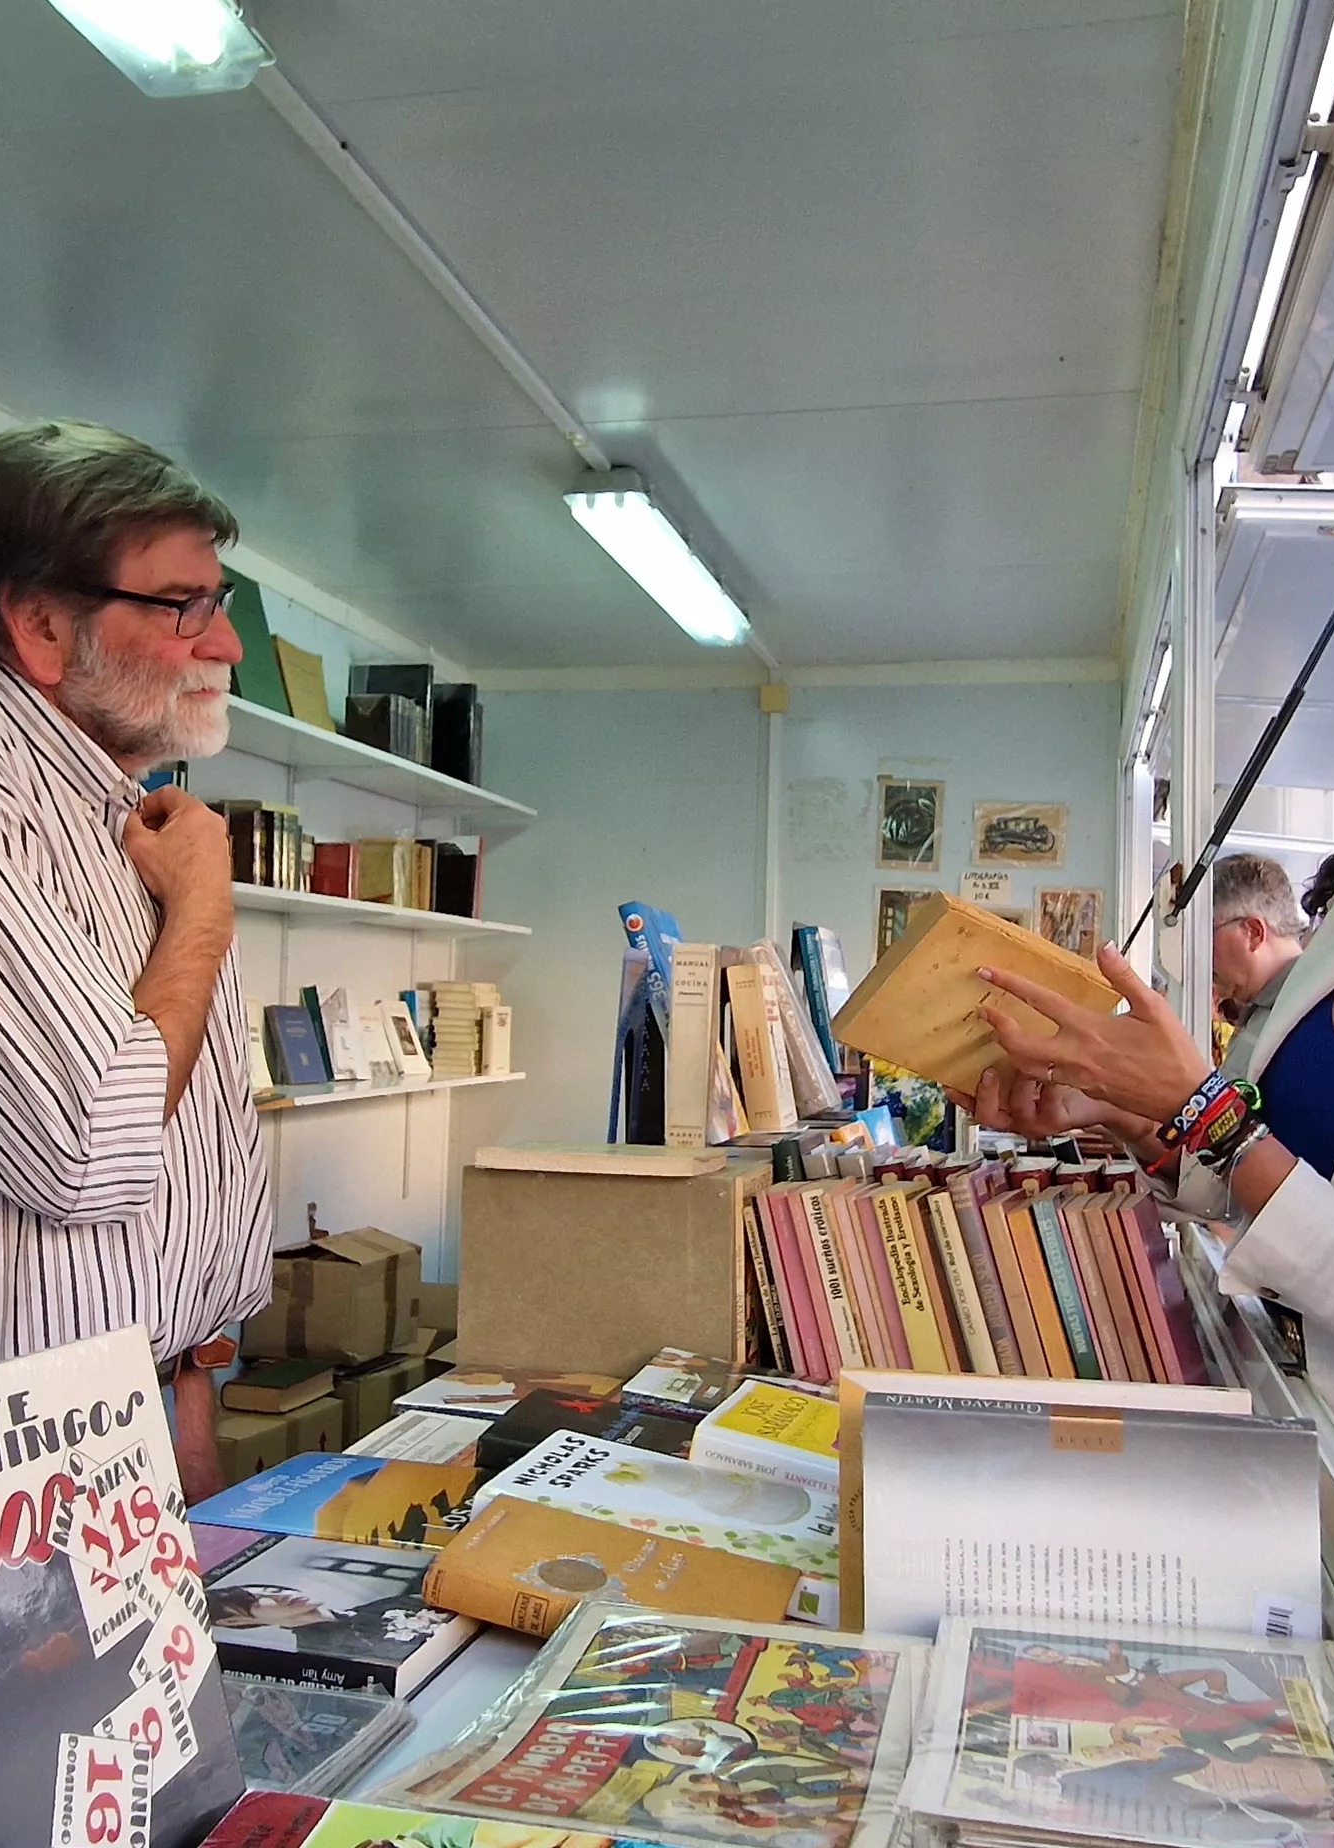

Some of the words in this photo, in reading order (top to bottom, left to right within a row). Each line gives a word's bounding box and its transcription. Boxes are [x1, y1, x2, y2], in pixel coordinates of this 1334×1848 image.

[675, 959, 710, 968] MANUAL
[674, 979, 709, 988] COCINA
[809, 1195, 828, 1237] eróticos
[877, 1198, 895, 1243] Ilustrada
[891, 1196, 907, 1241] Erotismo
[819, 1238, 838, 1275] sueños
[889, 1244, 912, 1306] Enciclopedia
[828, 1277, 844, 1300] 1001
[915, 1299, 925, 1312] de
[741, 1396, 775, 1419] JOSÉ
[756, 1395, 810, 1438] SARAMAGO
[885, 1394, 955, 1410] MARTÍN
[960, 1399, 1042, 1415] GUSTAVO
[94, 1446, 147, 1498] MAYO
[512, 1435, 587, 1487] NICHOLAS
[548, 1448, 610, 1489] SPARKS
[704, 1449, 754, 1470] SARAMAGO
[110, 1485, 161, 1559] 18
[301, 1667, 320, 1680] Tan
[321, 1667, 345, 1685] Amy
[60, 1734, 79, 1845] DOMINGO
[85, 1747, 123, 1845] 16
[470, 1783, 519, 1804] LA
